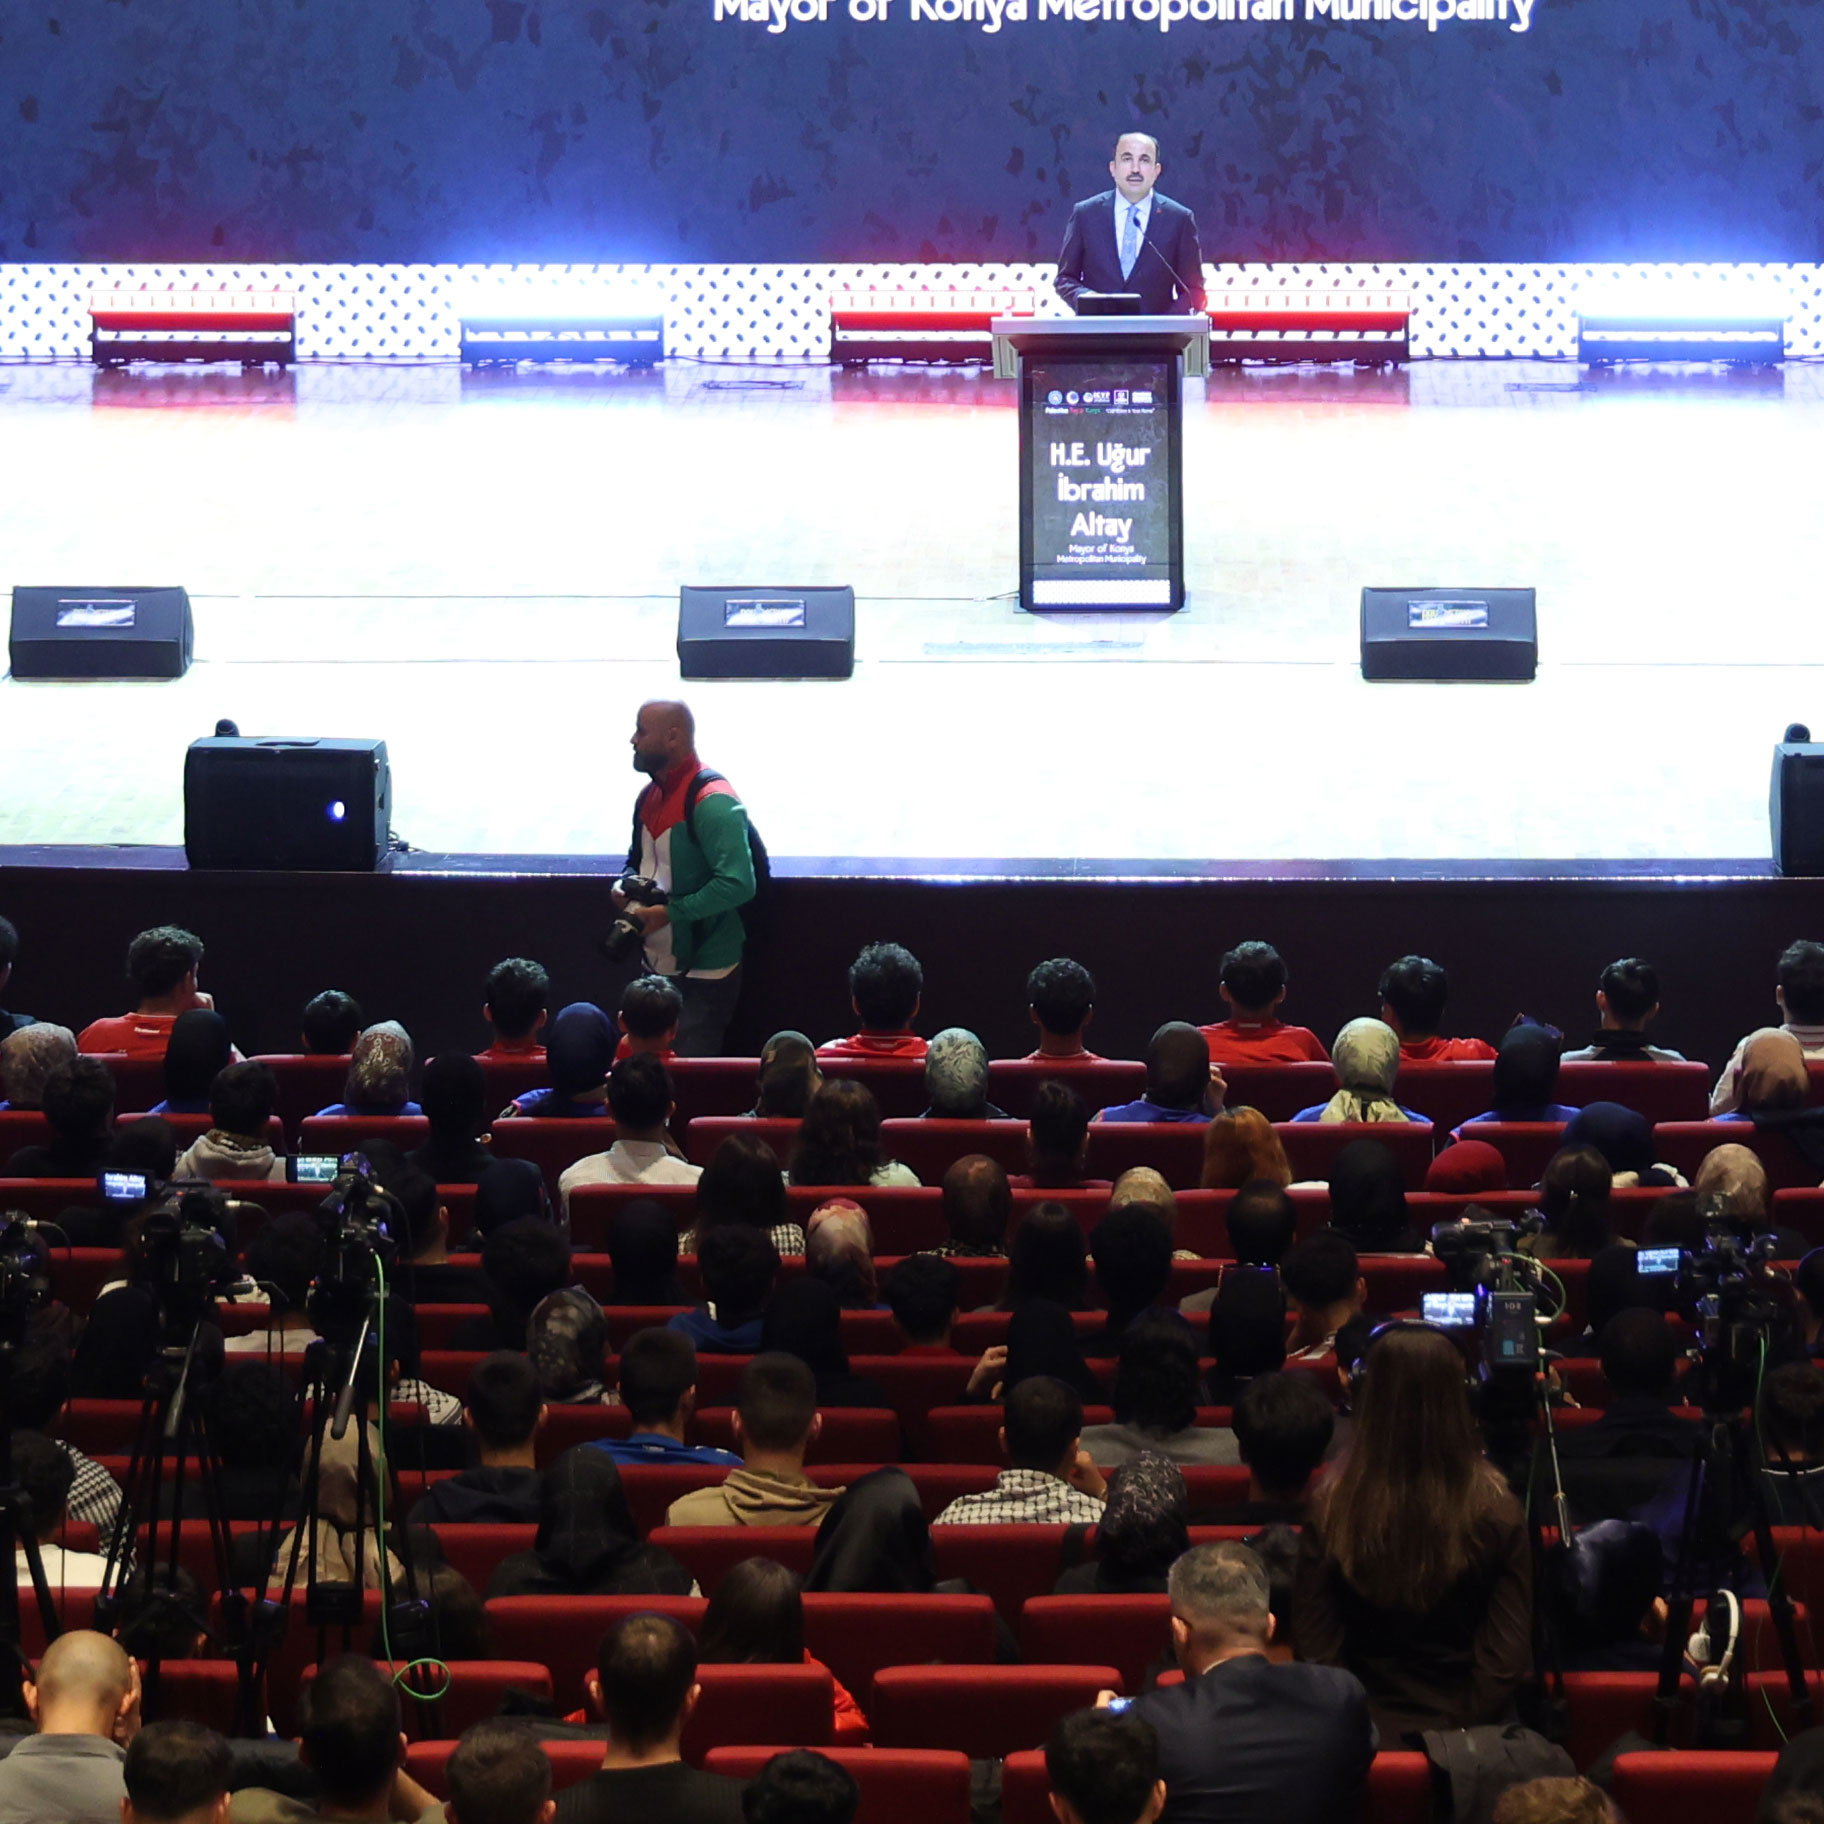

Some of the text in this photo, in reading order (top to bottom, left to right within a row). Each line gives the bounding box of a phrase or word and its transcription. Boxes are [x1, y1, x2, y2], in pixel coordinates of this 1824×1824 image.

[1050, 441, 1151, 474] H.E. Uğur
[1057, 472, 1145, 502] İbrahim
[1070, 510, 1133, 543] Altay
[1068, 543, 1135, 555] Mayor of Konya
